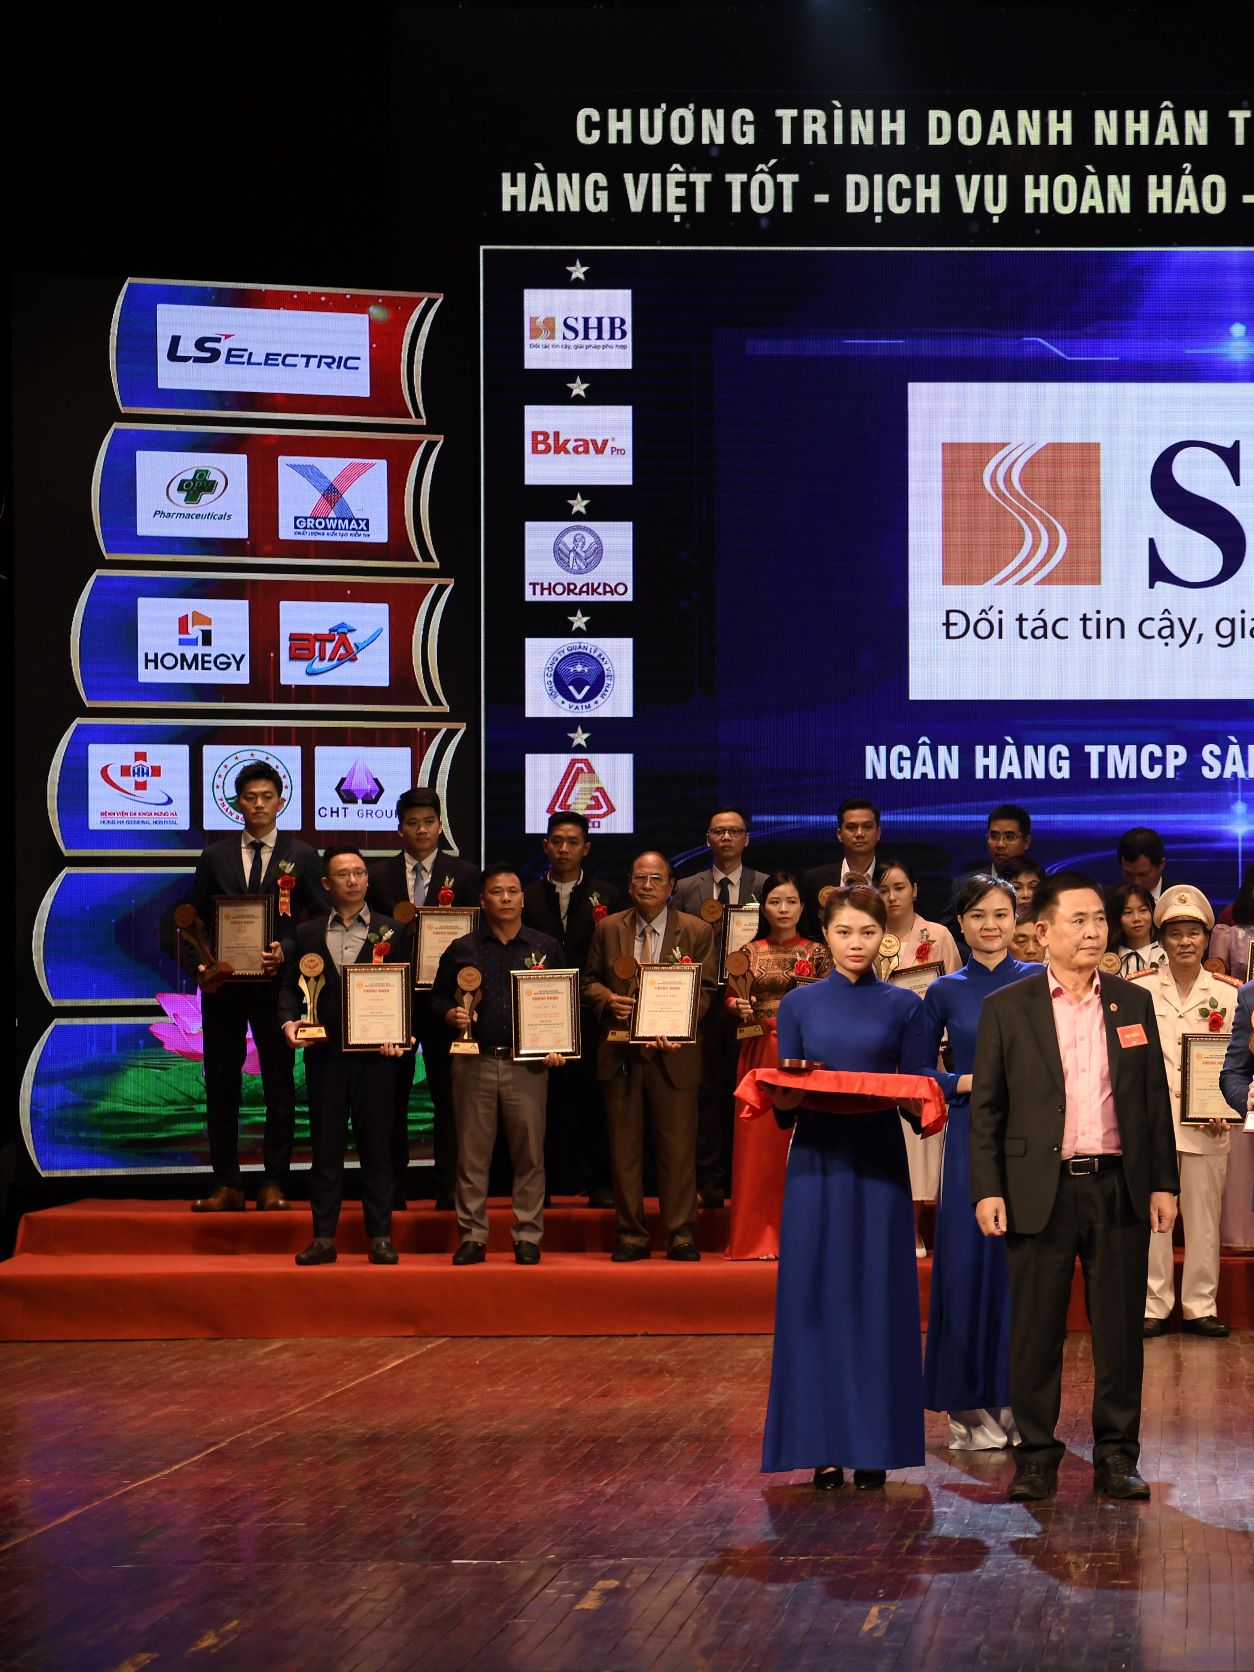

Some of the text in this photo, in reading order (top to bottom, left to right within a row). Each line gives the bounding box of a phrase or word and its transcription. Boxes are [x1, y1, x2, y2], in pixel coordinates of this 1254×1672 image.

[577, 103, 754, 145] CHƯƠNG
[775, 101, 905, 145] TRÌNH
[929, 109, 1072, 146] DOANH
[1095, 101, 1207, 145] NHÂN
[502, 163, 608, 212] HÀNG
[624, 164, 711, 222] VIỆT
[725, 159, 799, 213] TỐT
[815, 194, 829, 202] -
[846, 174, 939, 223] DỊCH
[955, 175, 1006, 223] VỤ
[1025, 165, 1130, 214] HOÀN
[1148, 163, 1226, 214] HẢO
[562, 316, 628, 341] SHB
[167, 334, 361, 370] LS ELECTRIC
[530, 430, 626, 456] Bkav Pro
[153, 510, 233, 521] Pharmaceuticals
[296, 518, 368, 530] GROWMAX
[528, 582, 628, 596] THORAKAO
[942, 606, 1003, 640] Đối
[1016, 608, 1068, 640] tác
[1080, 608, 1124, 640] tin
[1138, 608, 1203, 648] cậy,
[289, 632, 358, 661] BTA
[144, 652, 246, 671] HOMEGY
[866, 737, 958, 779] NGÂN
[976, 737, 1069, 779] HÀNG
[1085, 744, 1187, 779] TMCP
[318, 806, 349, 819] CHT
